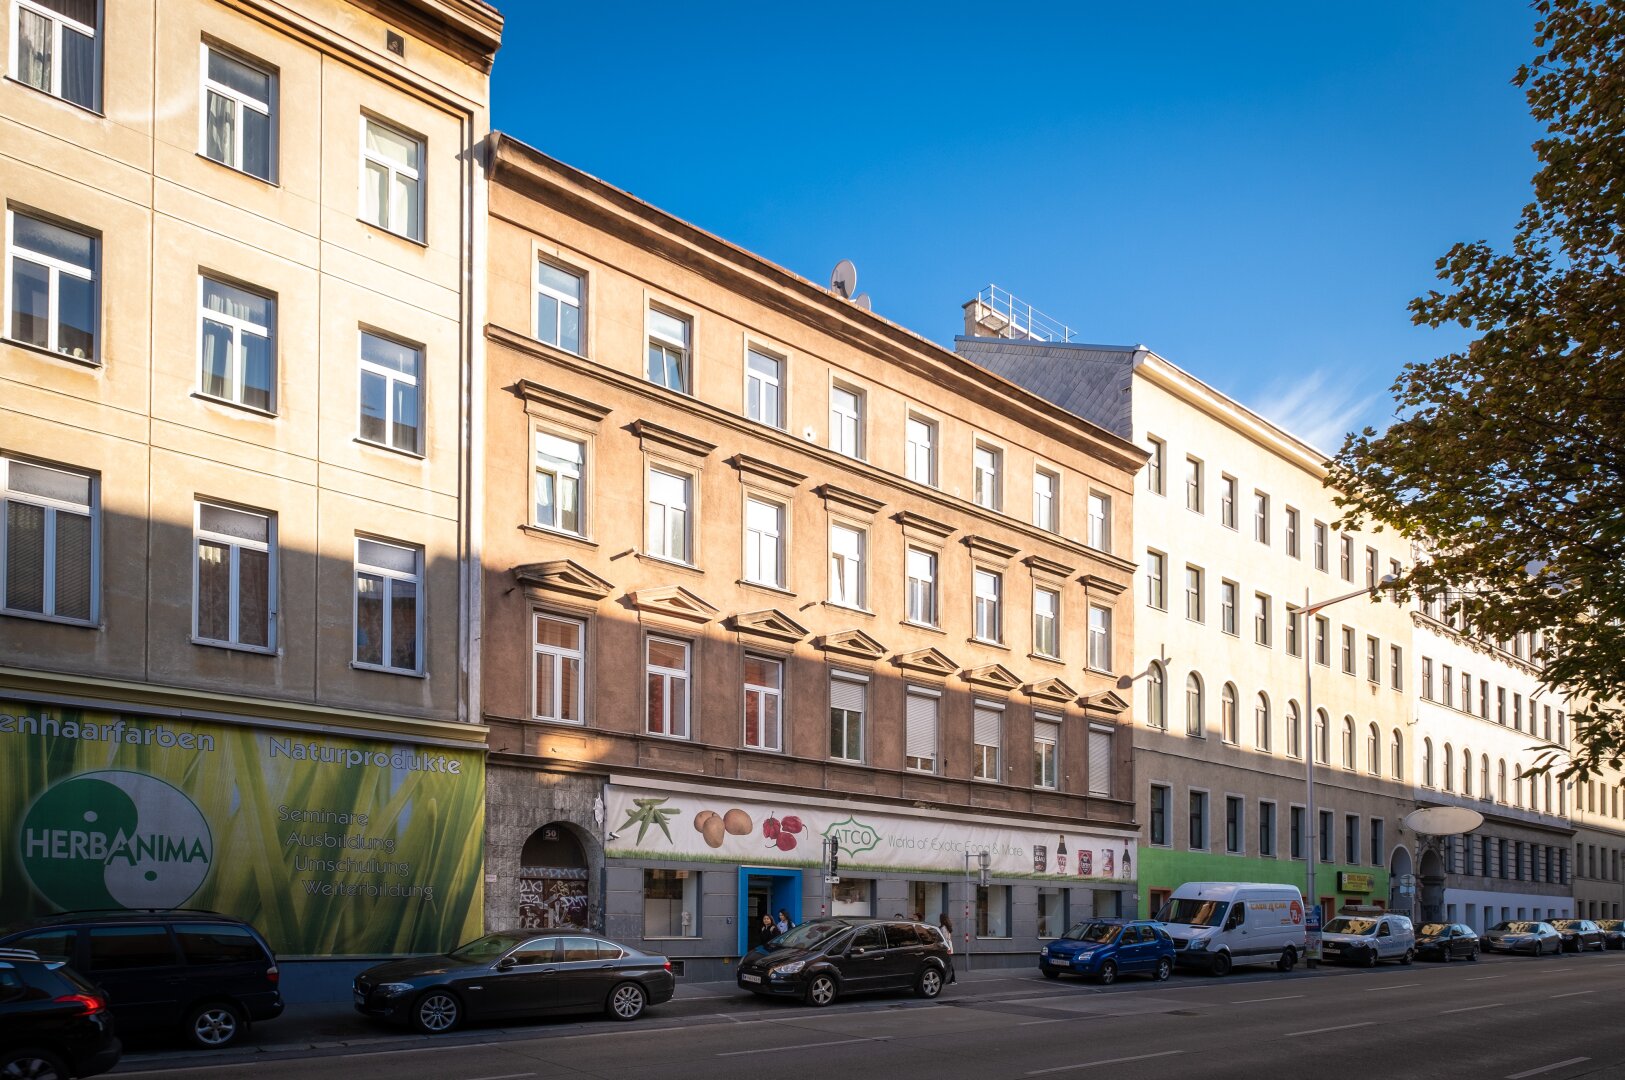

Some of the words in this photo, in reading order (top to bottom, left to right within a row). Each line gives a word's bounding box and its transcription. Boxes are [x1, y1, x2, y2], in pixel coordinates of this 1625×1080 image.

[269, 736, 462, 774] Naturprodukte
[278, 804, 369, 826] Seminare
[26, 827, 209, 867] HERBANIMA
[286, 832, 395, 853] Ausbildung
[834, 828, 872, 845] ATCO
[887, 834, 915, 849] World
[917, 837, 929, 850] of
[931, 838, 962, 852] Exotic
[1001, 844, 1023, 856] More
[295, 855, 409, 877] Umschulung
[301, 879, 434, 900] Weiterbildung
